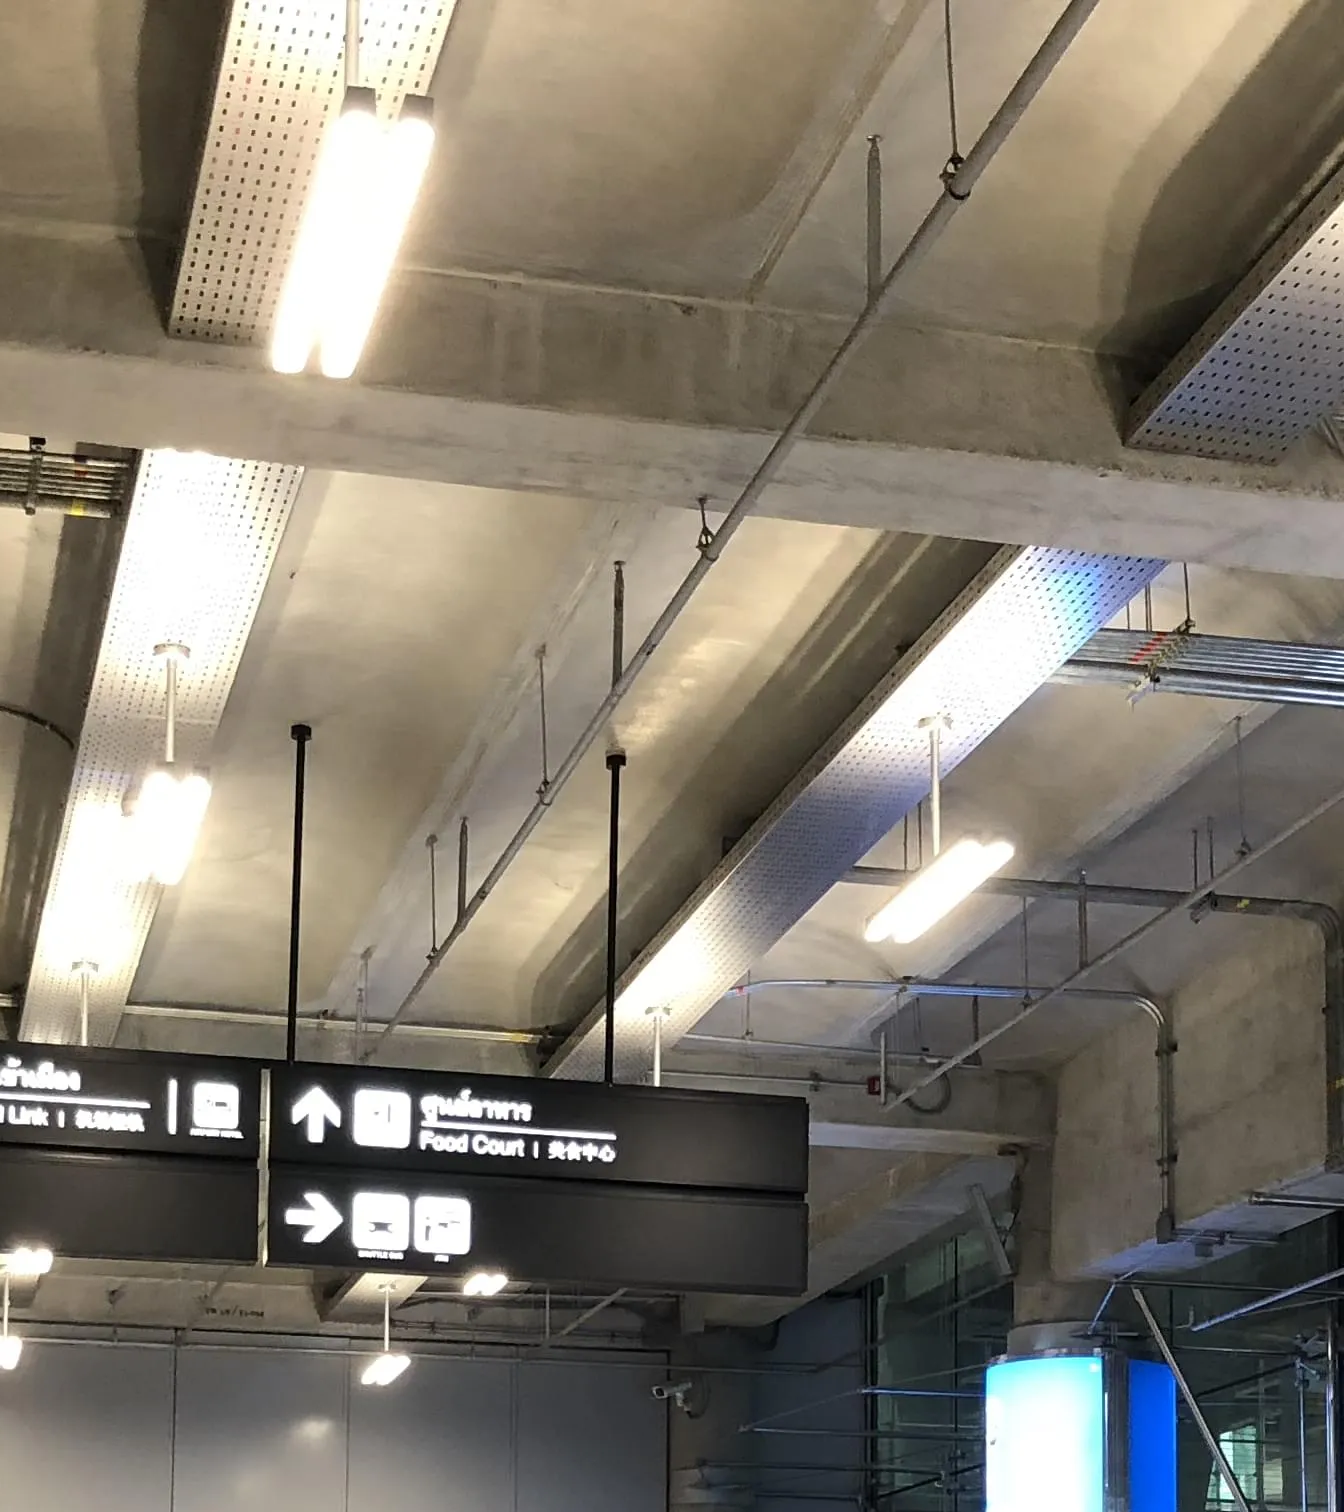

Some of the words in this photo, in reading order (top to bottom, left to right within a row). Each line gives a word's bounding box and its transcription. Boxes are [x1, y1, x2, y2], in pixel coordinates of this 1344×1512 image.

[9, 1106, 49, 1127] Link
[420, 1130, 468, 1154] Food
[472, 1134, 525, 1157] Court
